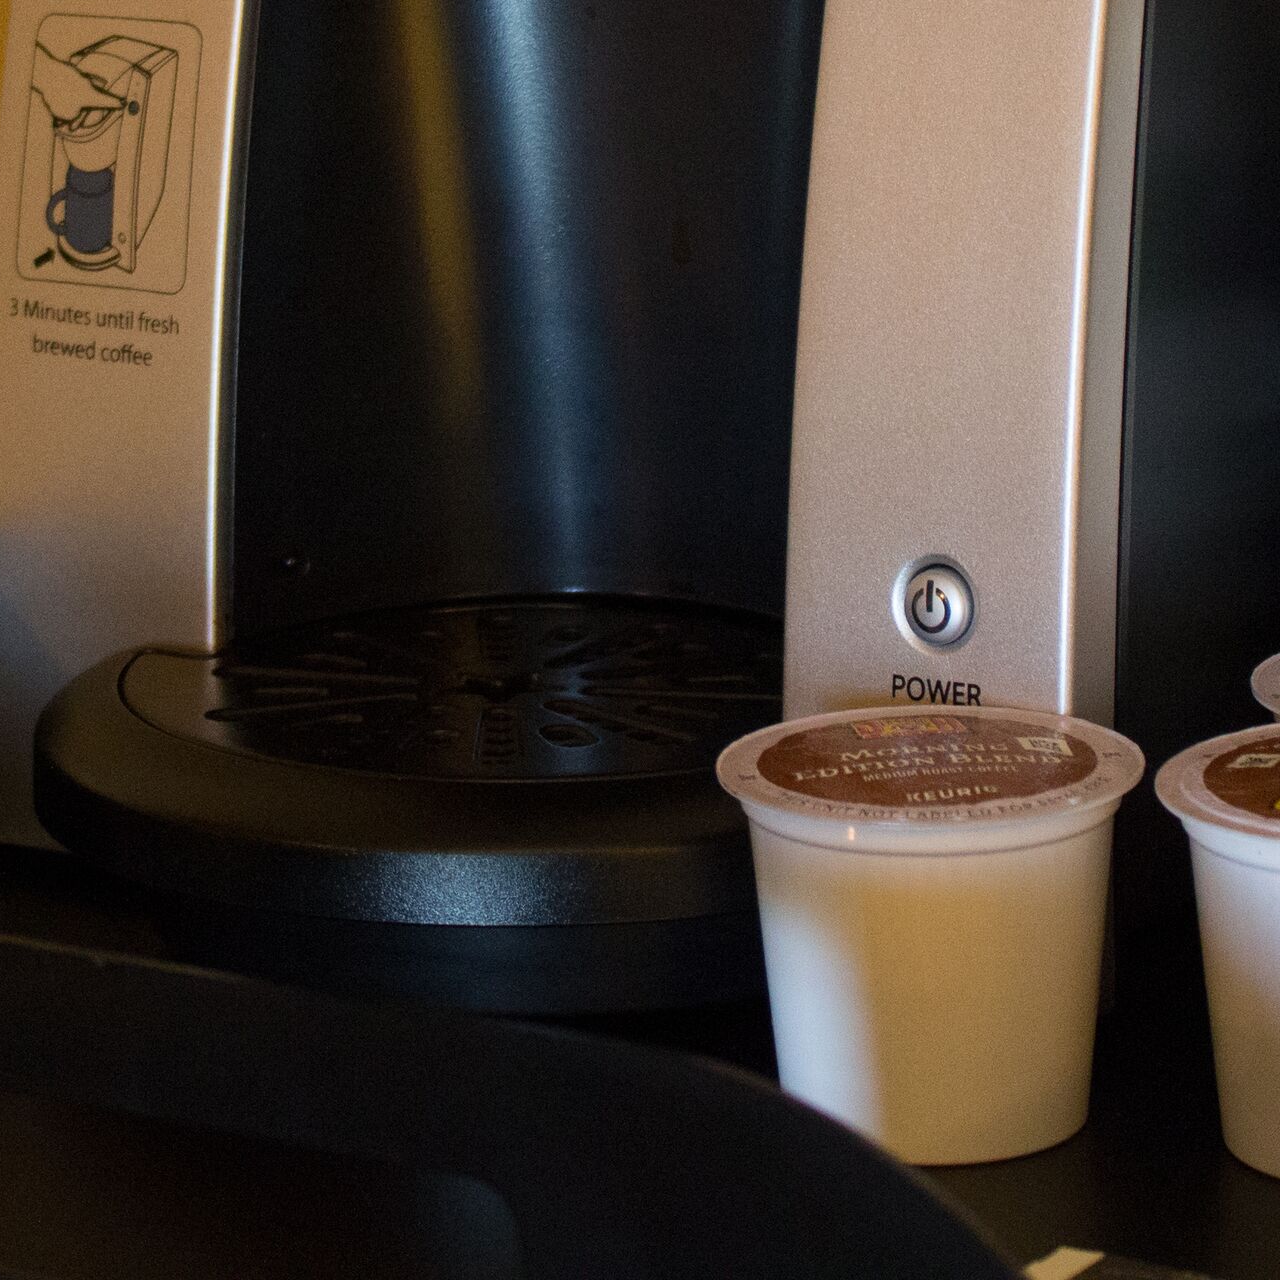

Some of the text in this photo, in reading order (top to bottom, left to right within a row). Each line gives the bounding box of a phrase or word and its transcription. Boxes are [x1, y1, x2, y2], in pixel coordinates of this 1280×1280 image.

[8, 297, 180, 335] 3 Minutes until fresh
[32, 334, 153, 367] brewed coffee
[891, 673, 982, 707] POWER
[840, 742, 1009, 761] MORNING
[791, 756, 936, 781] EDITION
[862, 767, 920, 782] MEDIUM
[905, 784, 999, 803] KEURIG
